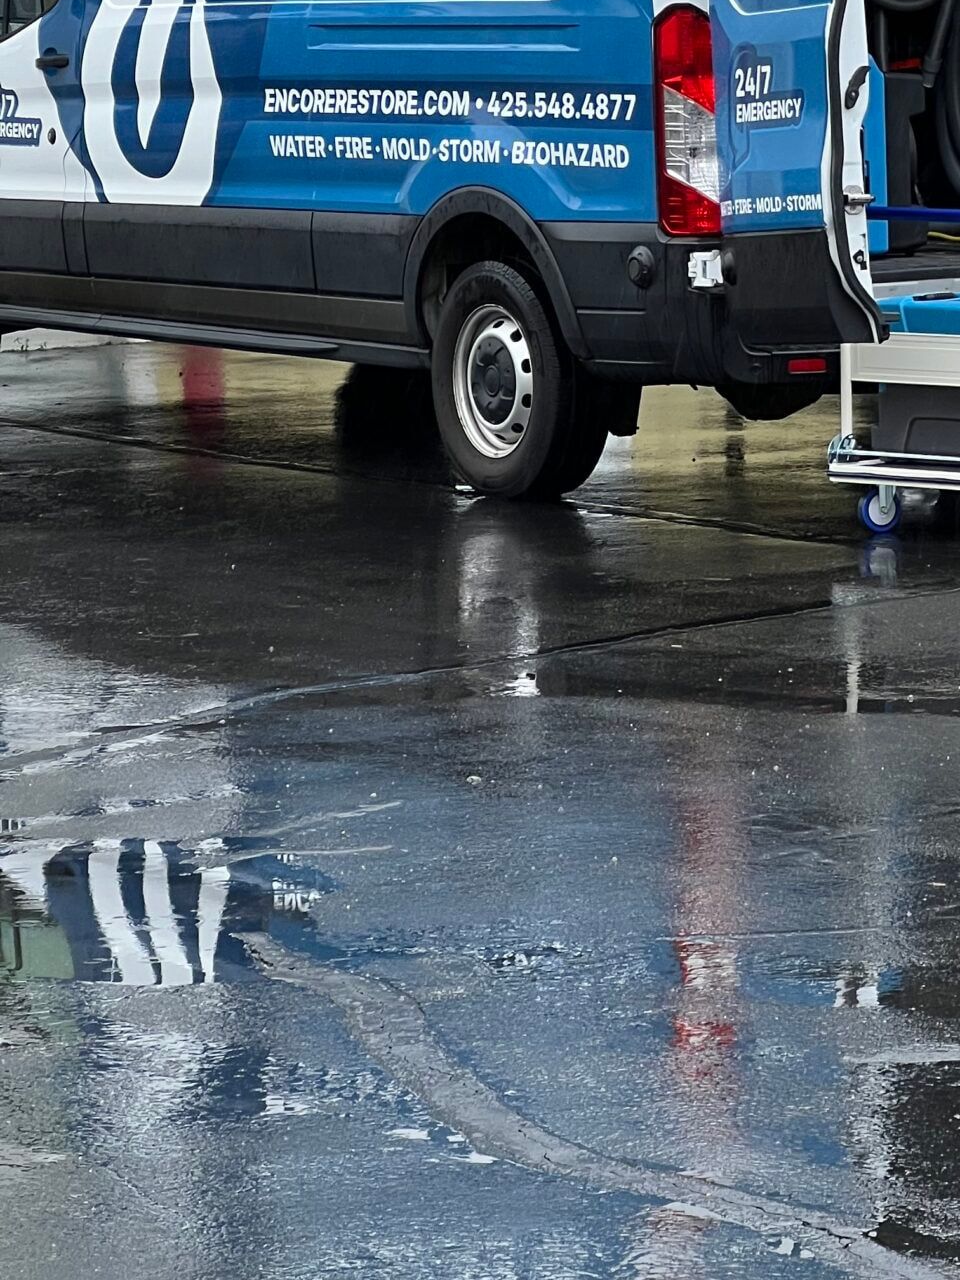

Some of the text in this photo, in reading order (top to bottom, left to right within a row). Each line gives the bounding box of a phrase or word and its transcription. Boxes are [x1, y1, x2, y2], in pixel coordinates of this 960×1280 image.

[734, 65, 771, 100] 24/7
[263, 88, 636, 121] ENCORERESTORE.COM 425.548.4877
[735, 97, 802, 124] EMERGENCY
[269, 135, 630, 169] WATER FIRE MOLD STORM BIOHAZARD
[734, 198, 753, 215] FIRE
[756, 196, 782, 214] MOLD
[786, 193, 822, 213] STORM
